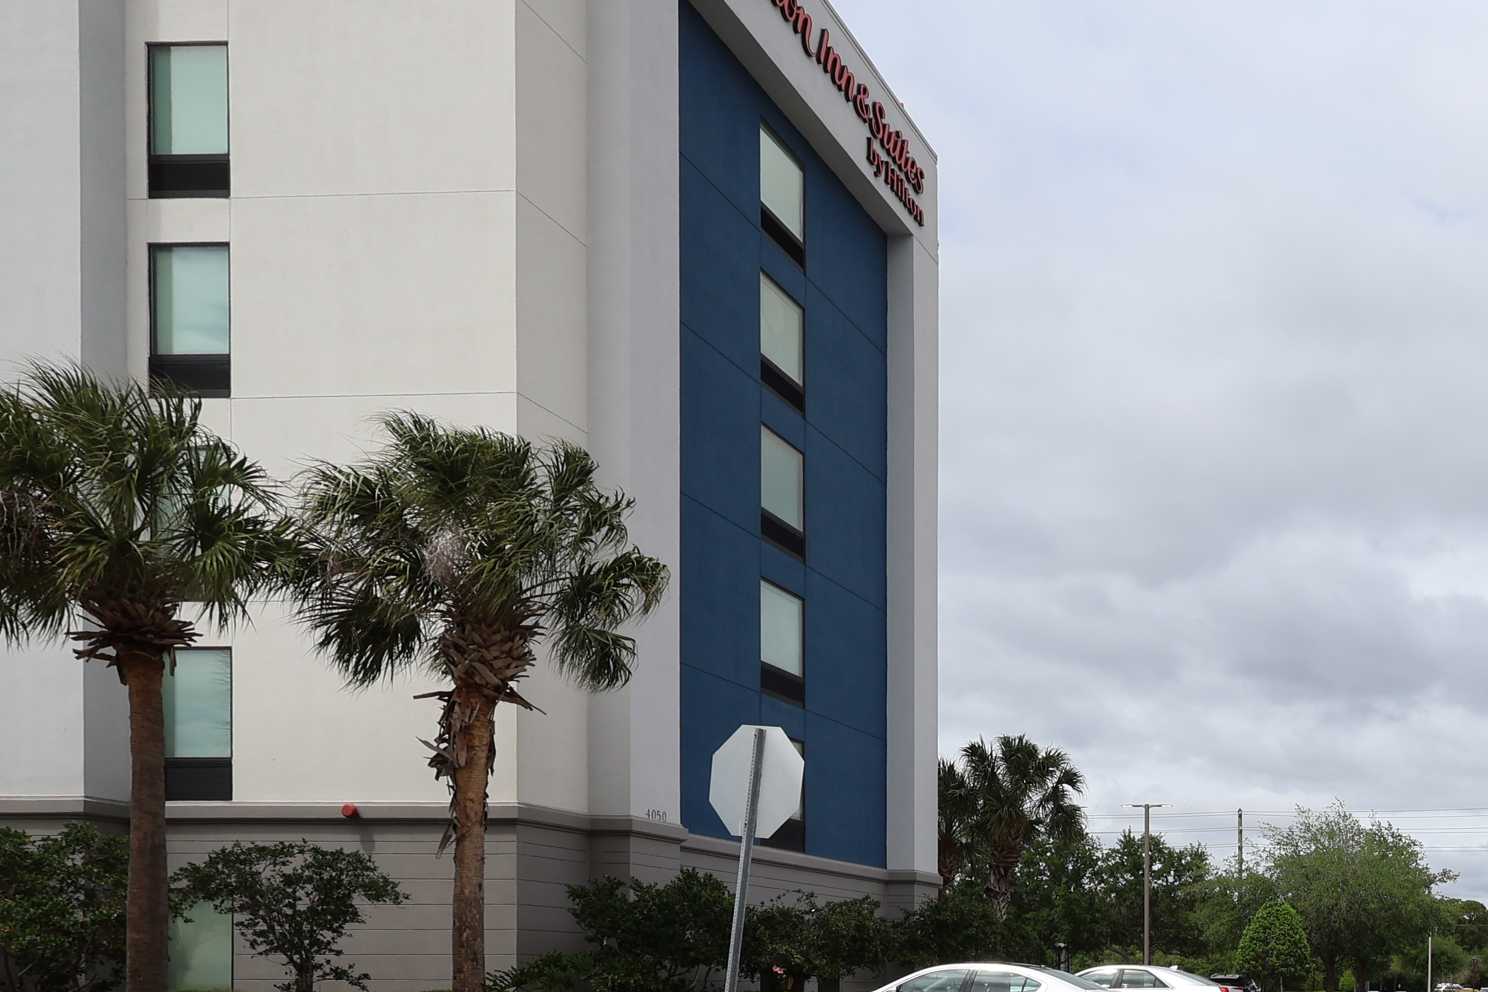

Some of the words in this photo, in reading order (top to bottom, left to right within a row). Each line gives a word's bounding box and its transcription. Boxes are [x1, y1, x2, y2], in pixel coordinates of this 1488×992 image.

[816, 28, 855, 103] Inn
[853, 83, 870, 124] &
[868, 101, 925, 195] Suites
[866, 137, 884, 178] by
[884, 161, 924, 227] Hilton
